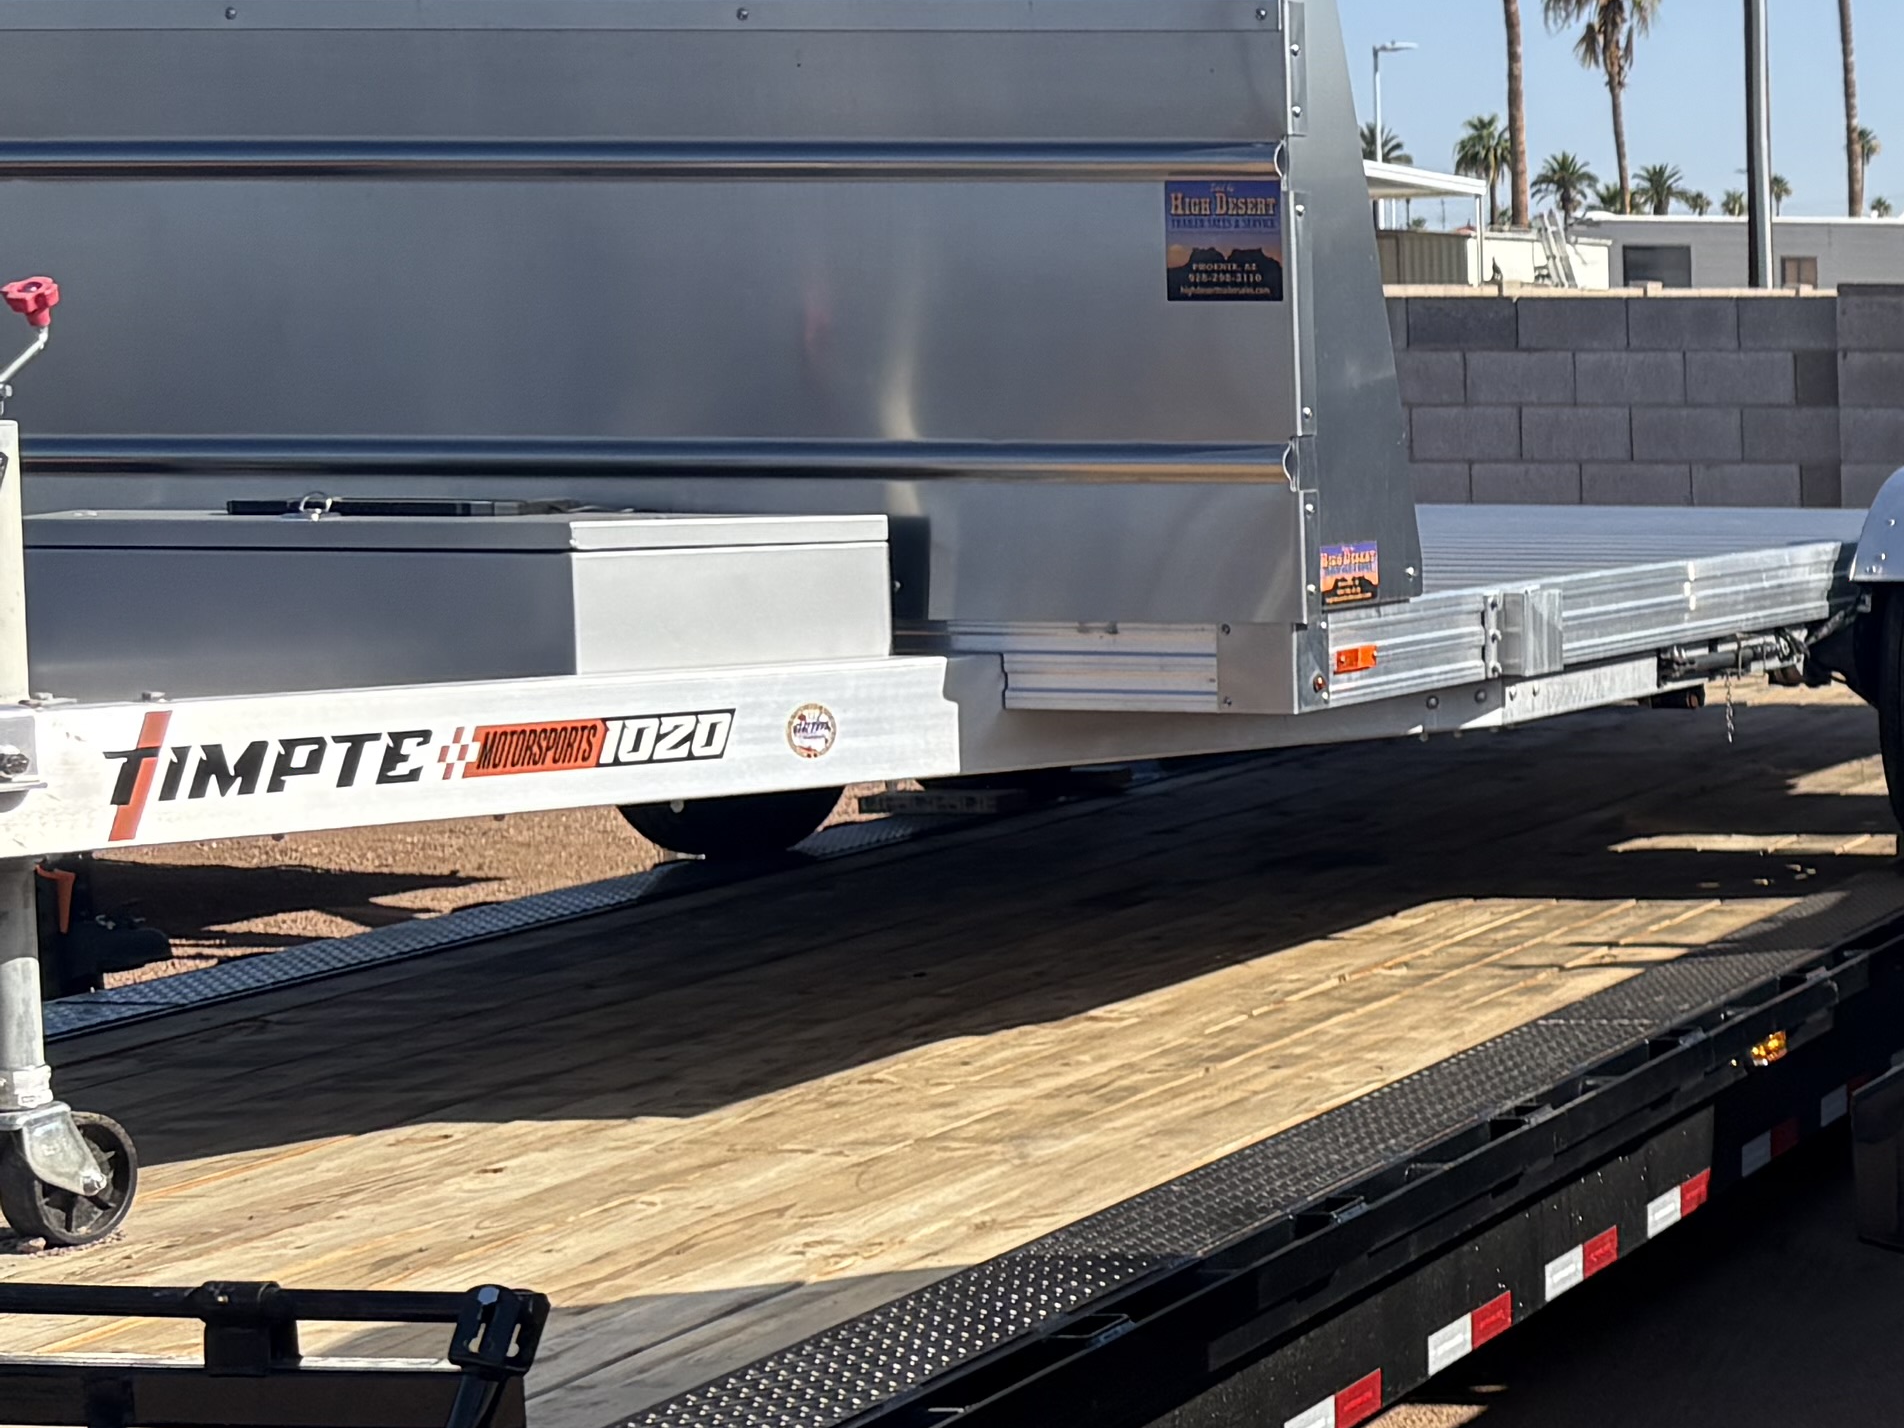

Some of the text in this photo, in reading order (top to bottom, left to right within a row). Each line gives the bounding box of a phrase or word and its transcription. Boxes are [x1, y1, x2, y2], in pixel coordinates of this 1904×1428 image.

[102, 710, 433, 842] TIMPTE
[476, 724, 598, 771] MOTORSPORTS
[599, 712, 732, 765] 1020
